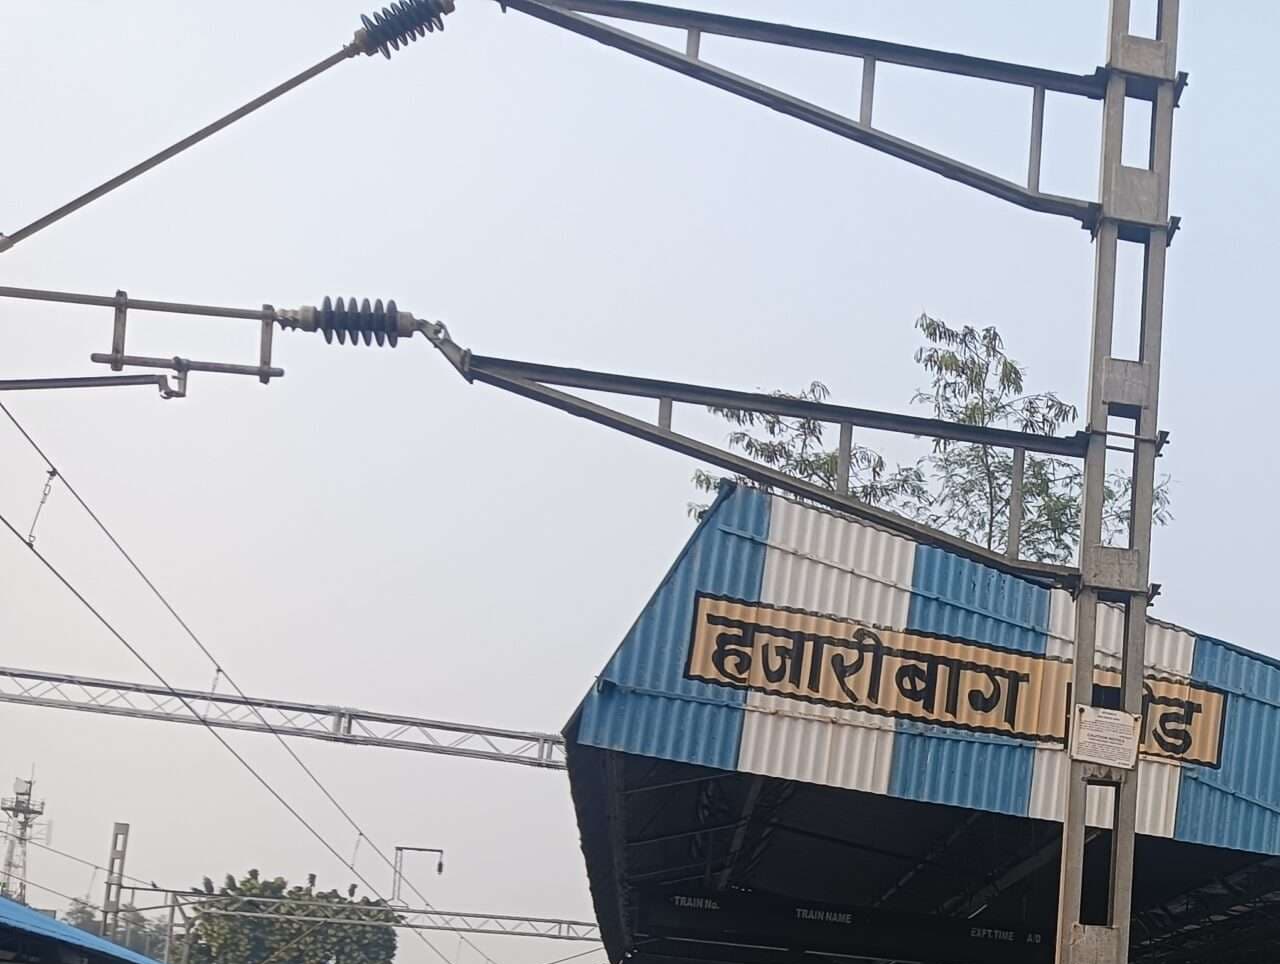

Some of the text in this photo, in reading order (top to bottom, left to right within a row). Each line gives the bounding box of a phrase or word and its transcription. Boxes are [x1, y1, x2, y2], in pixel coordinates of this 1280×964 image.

[706, 613, 1031, 730] हजारीबाग
[674, 895, 703, 908] TRAIN
[796, 908, 852, 924] TRAIN NAME
